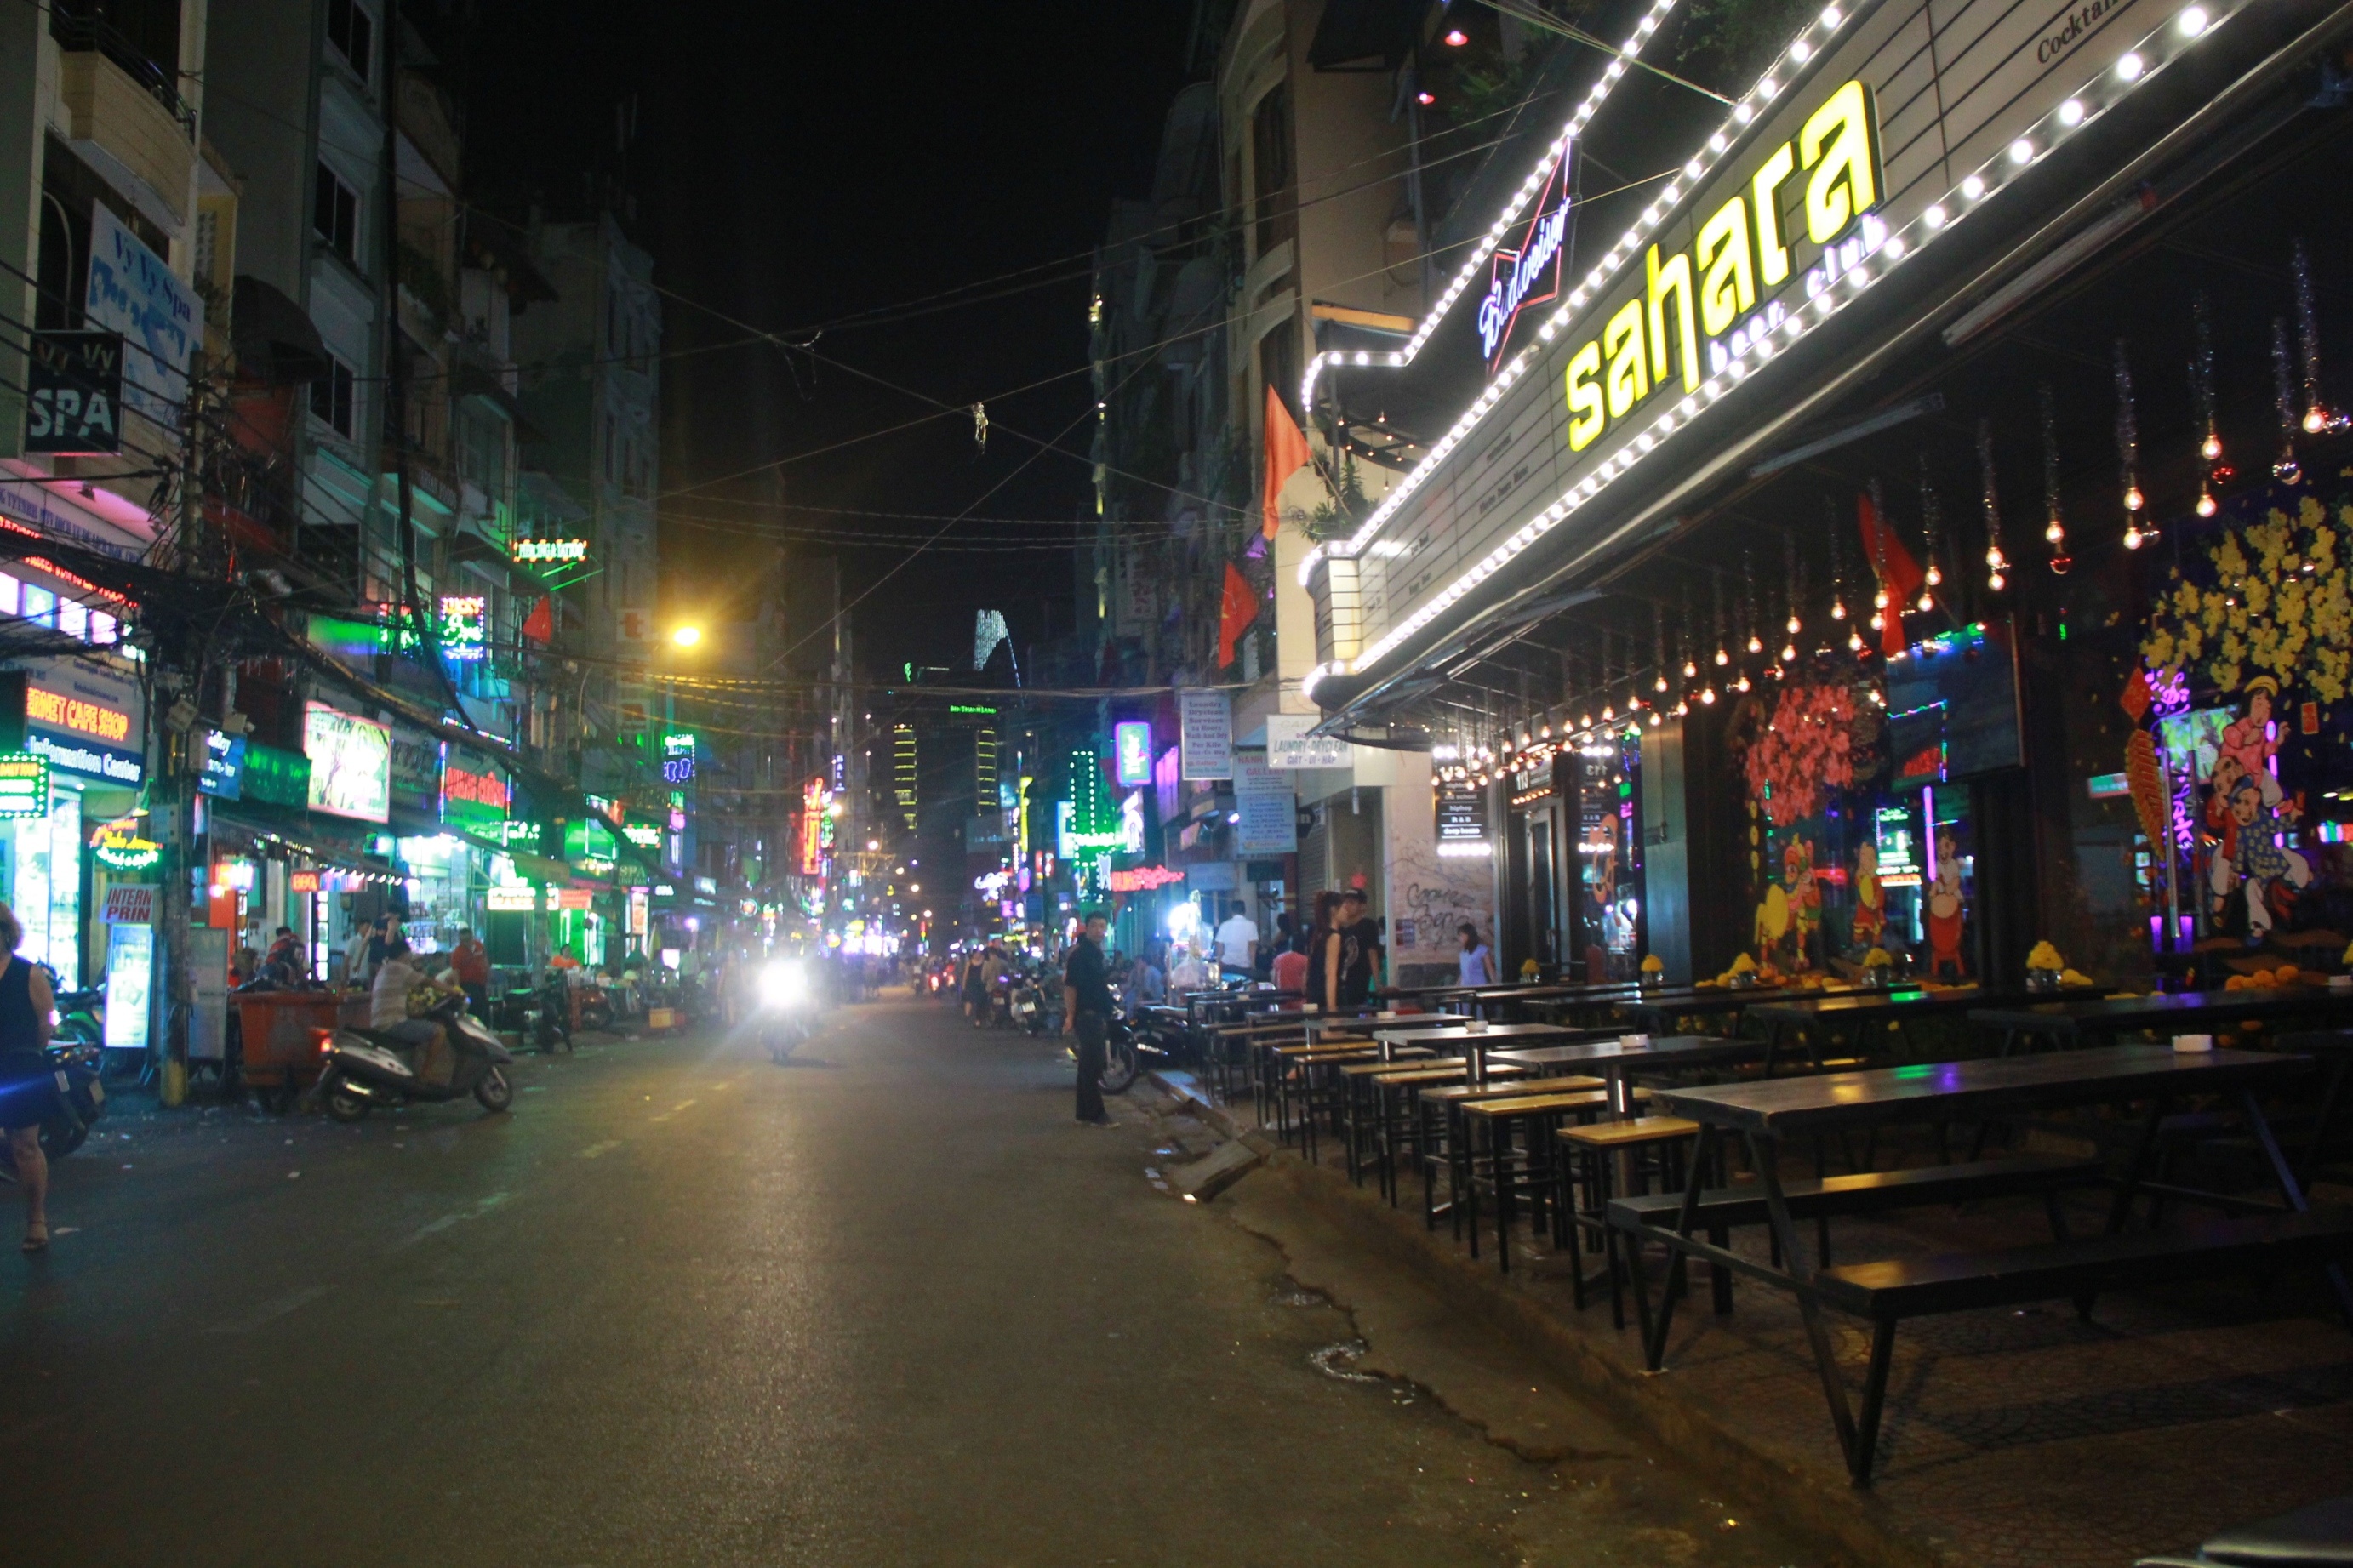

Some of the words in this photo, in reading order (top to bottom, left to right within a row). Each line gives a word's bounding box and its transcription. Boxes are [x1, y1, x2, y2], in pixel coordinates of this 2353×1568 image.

[1479, 197, 1571, 360] Budweiser
[1565, 78, 1876, 453] sahara
[1710, 299, 1785, 374] beer
[1806, 212, 1888, 299] club
[30, 387, 114, 437] SPA
[67, 699, 99, 734] CAFE
[99, 708, 129, 742] SHOP
[30, 735, 102, 774] Information
[105, 751, 140, 782] Center
[293, 874, 317, 891] BBQ
